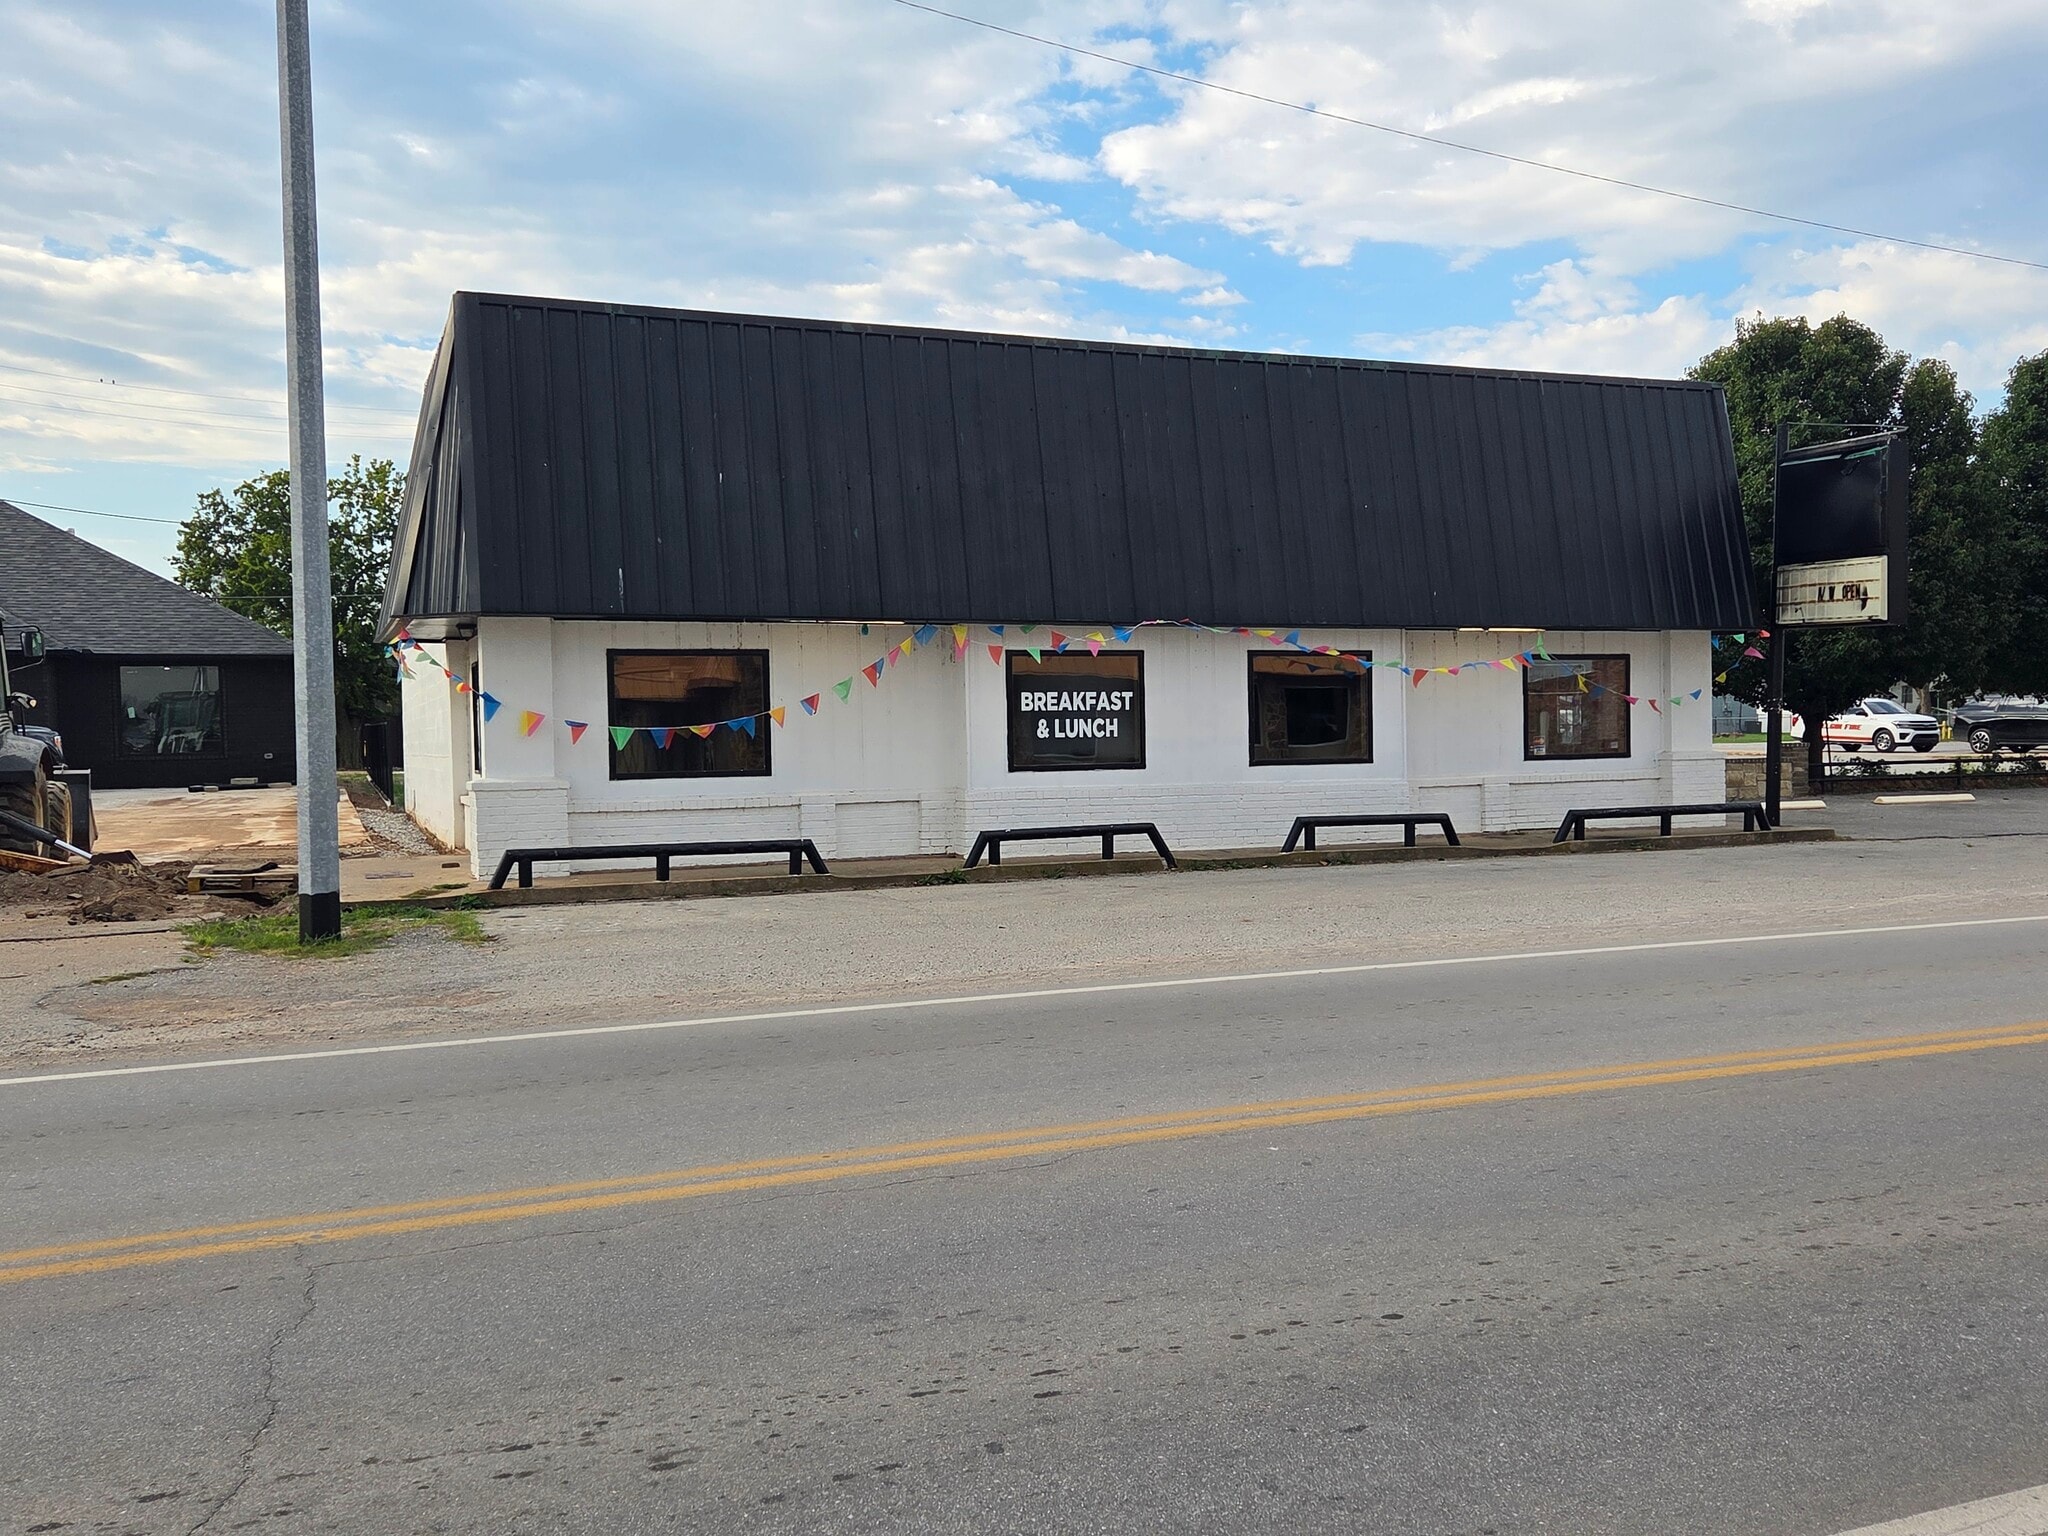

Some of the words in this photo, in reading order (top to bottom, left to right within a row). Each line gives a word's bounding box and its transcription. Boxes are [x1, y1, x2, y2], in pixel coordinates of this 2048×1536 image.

[1842, 583, 1861, 599] OPEN
[1020, 691, 1133, 711] BREAKFAST
[1036, 718, 1049, 739] &
[1054, 718, 1118, 738] LUNCH
